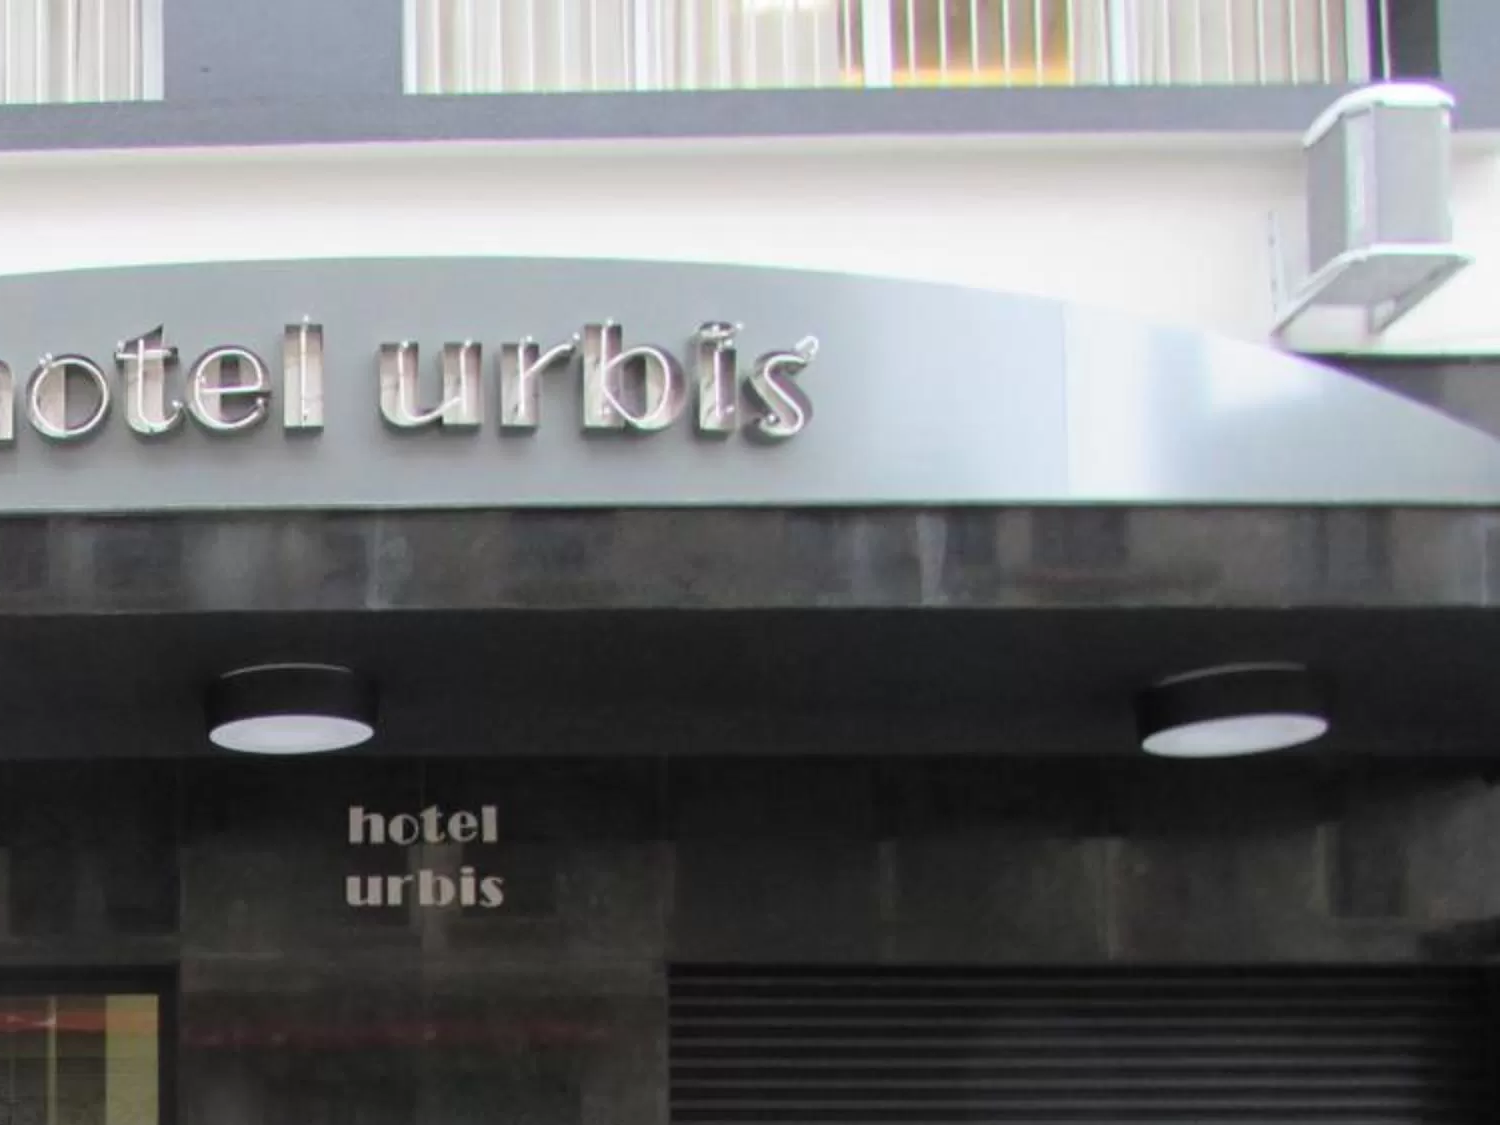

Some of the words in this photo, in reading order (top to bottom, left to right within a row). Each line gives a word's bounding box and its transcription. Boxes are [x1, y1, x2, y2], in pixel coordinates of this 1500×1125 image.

[378, 317, 818, 440] urbis
[348, 804, 498, 845] hotel
[346, 866, 505, 908] urbis
